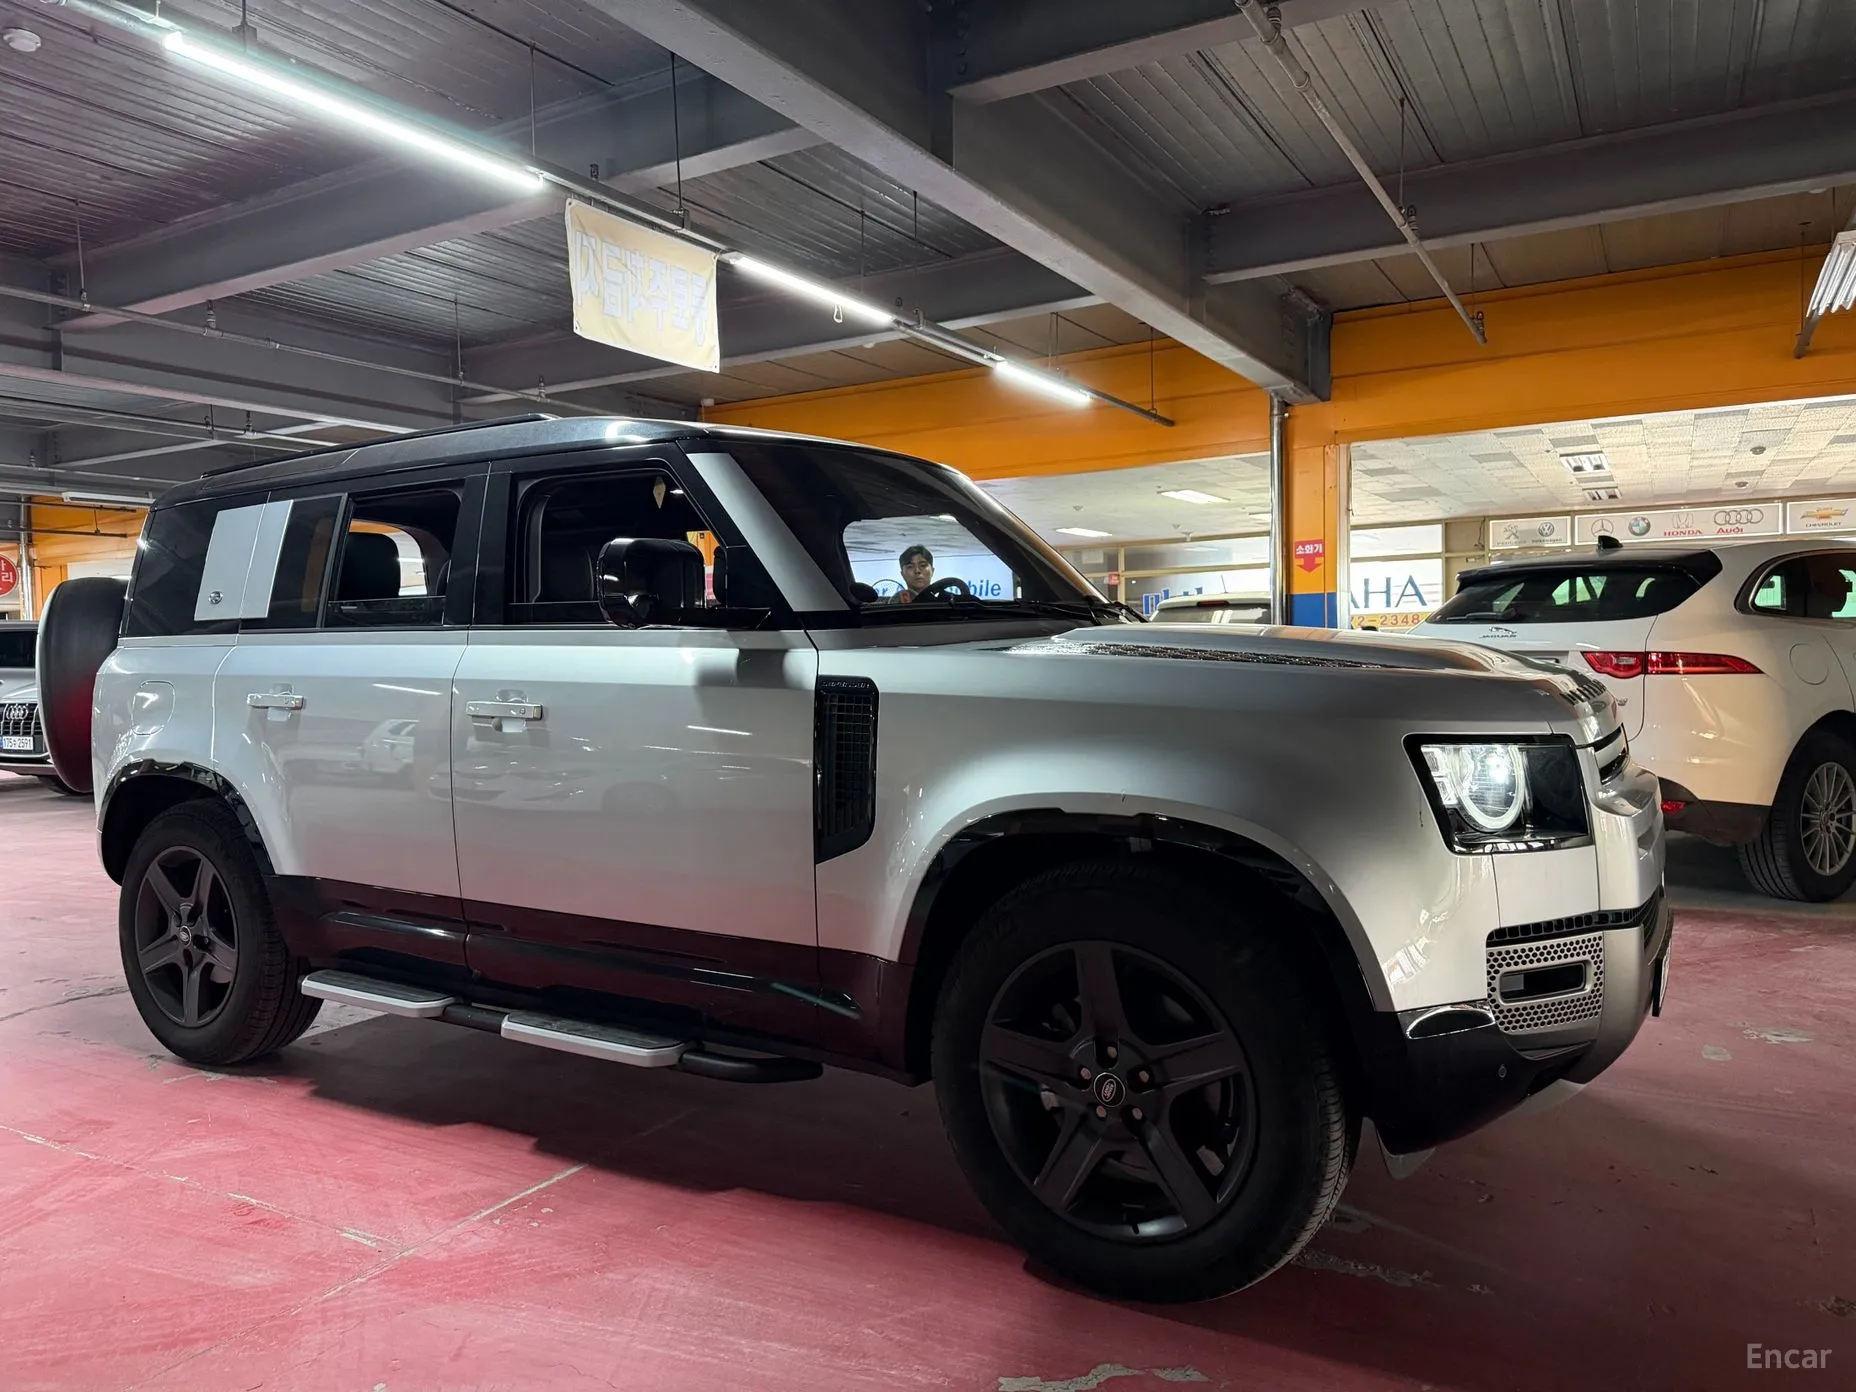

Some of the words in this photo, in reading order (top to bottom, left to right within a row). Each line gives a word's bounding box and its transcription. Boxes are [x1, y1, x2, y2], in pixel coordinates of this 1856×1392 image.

[1663, 529, 1703, 537] HONDA
[1295, 543, 1323, 555] 소화기
[1351, 613, 1420, 627] 2-2348
